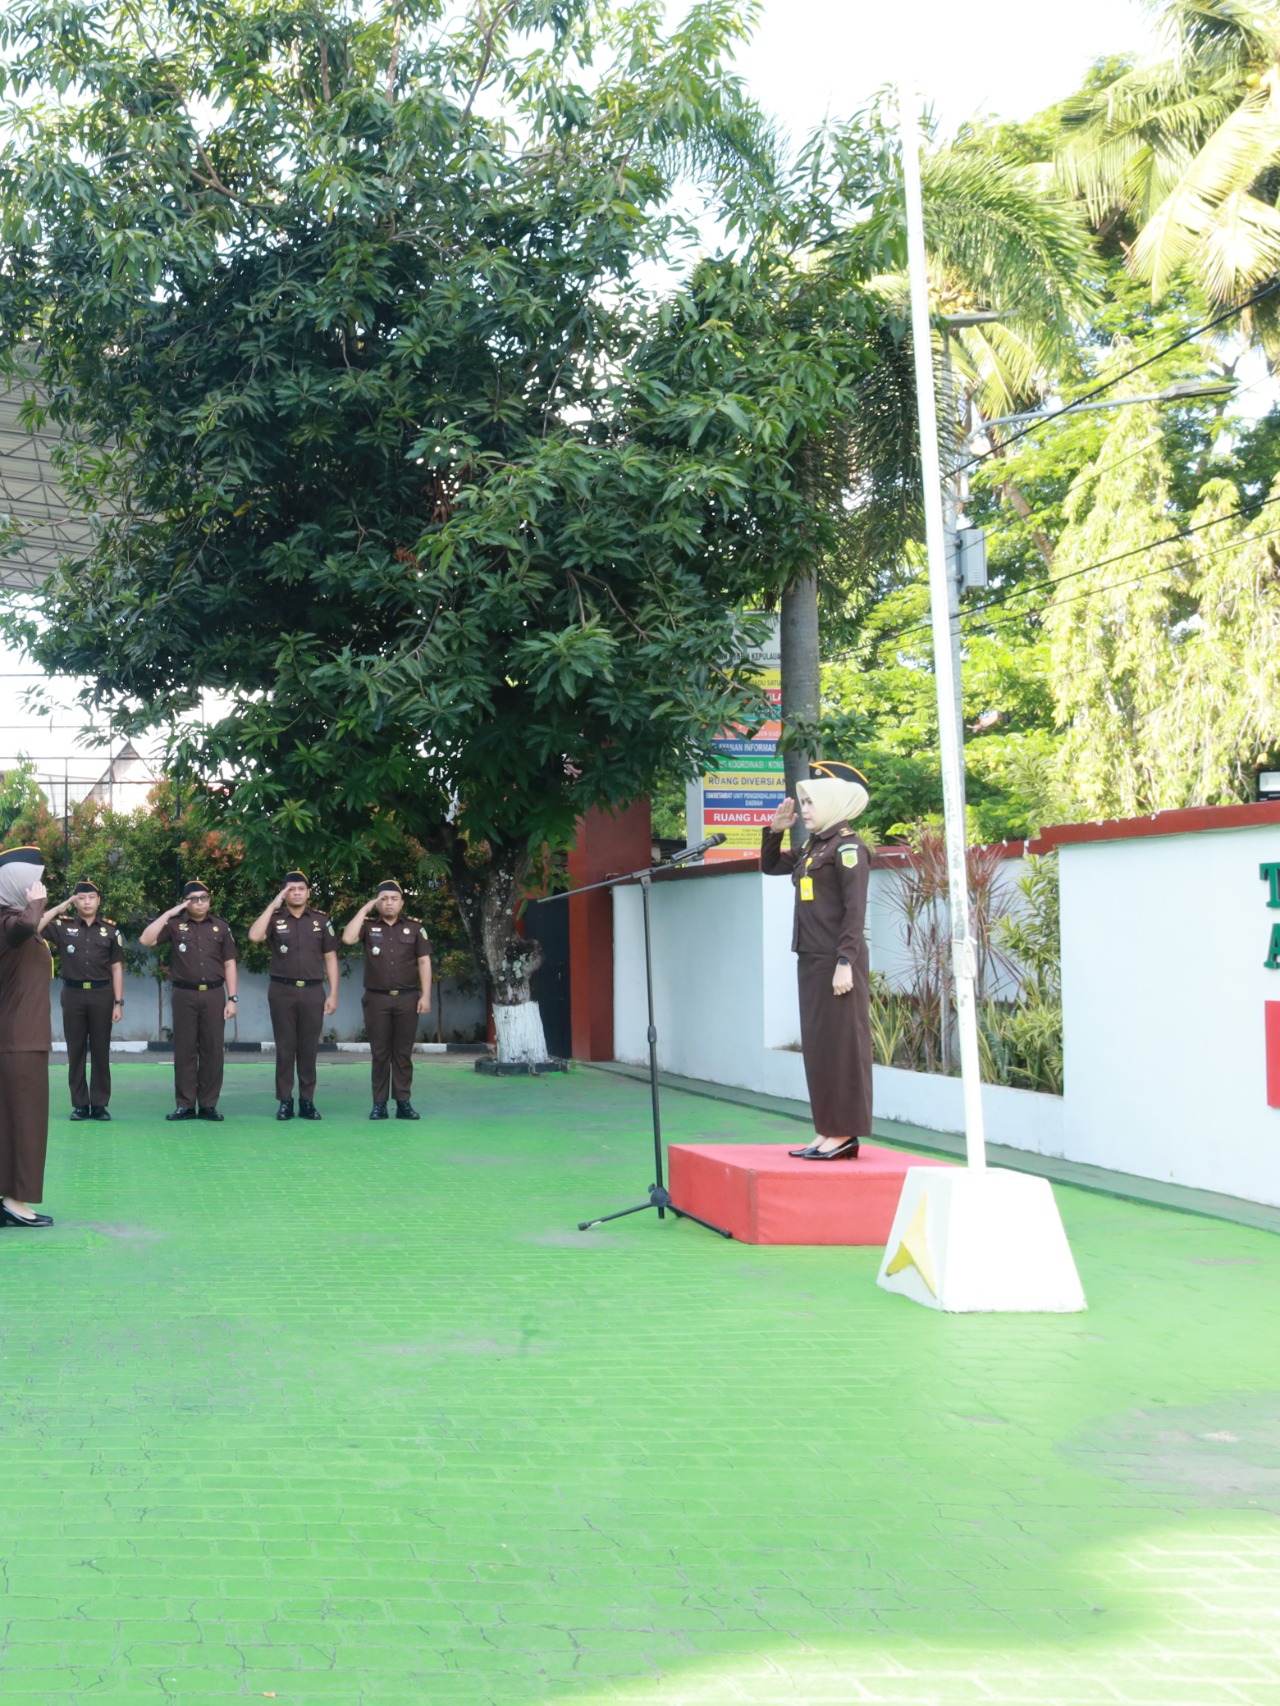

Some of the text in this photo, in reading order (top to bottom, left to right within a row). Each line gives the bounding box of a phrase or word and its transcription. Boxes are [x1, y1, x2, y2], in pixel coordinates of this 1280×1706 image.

[708, 776, 739, 785] RUANG
[741, 777, 775, 785] DIVERSI
[713, 813, 751, 822] RUANG
